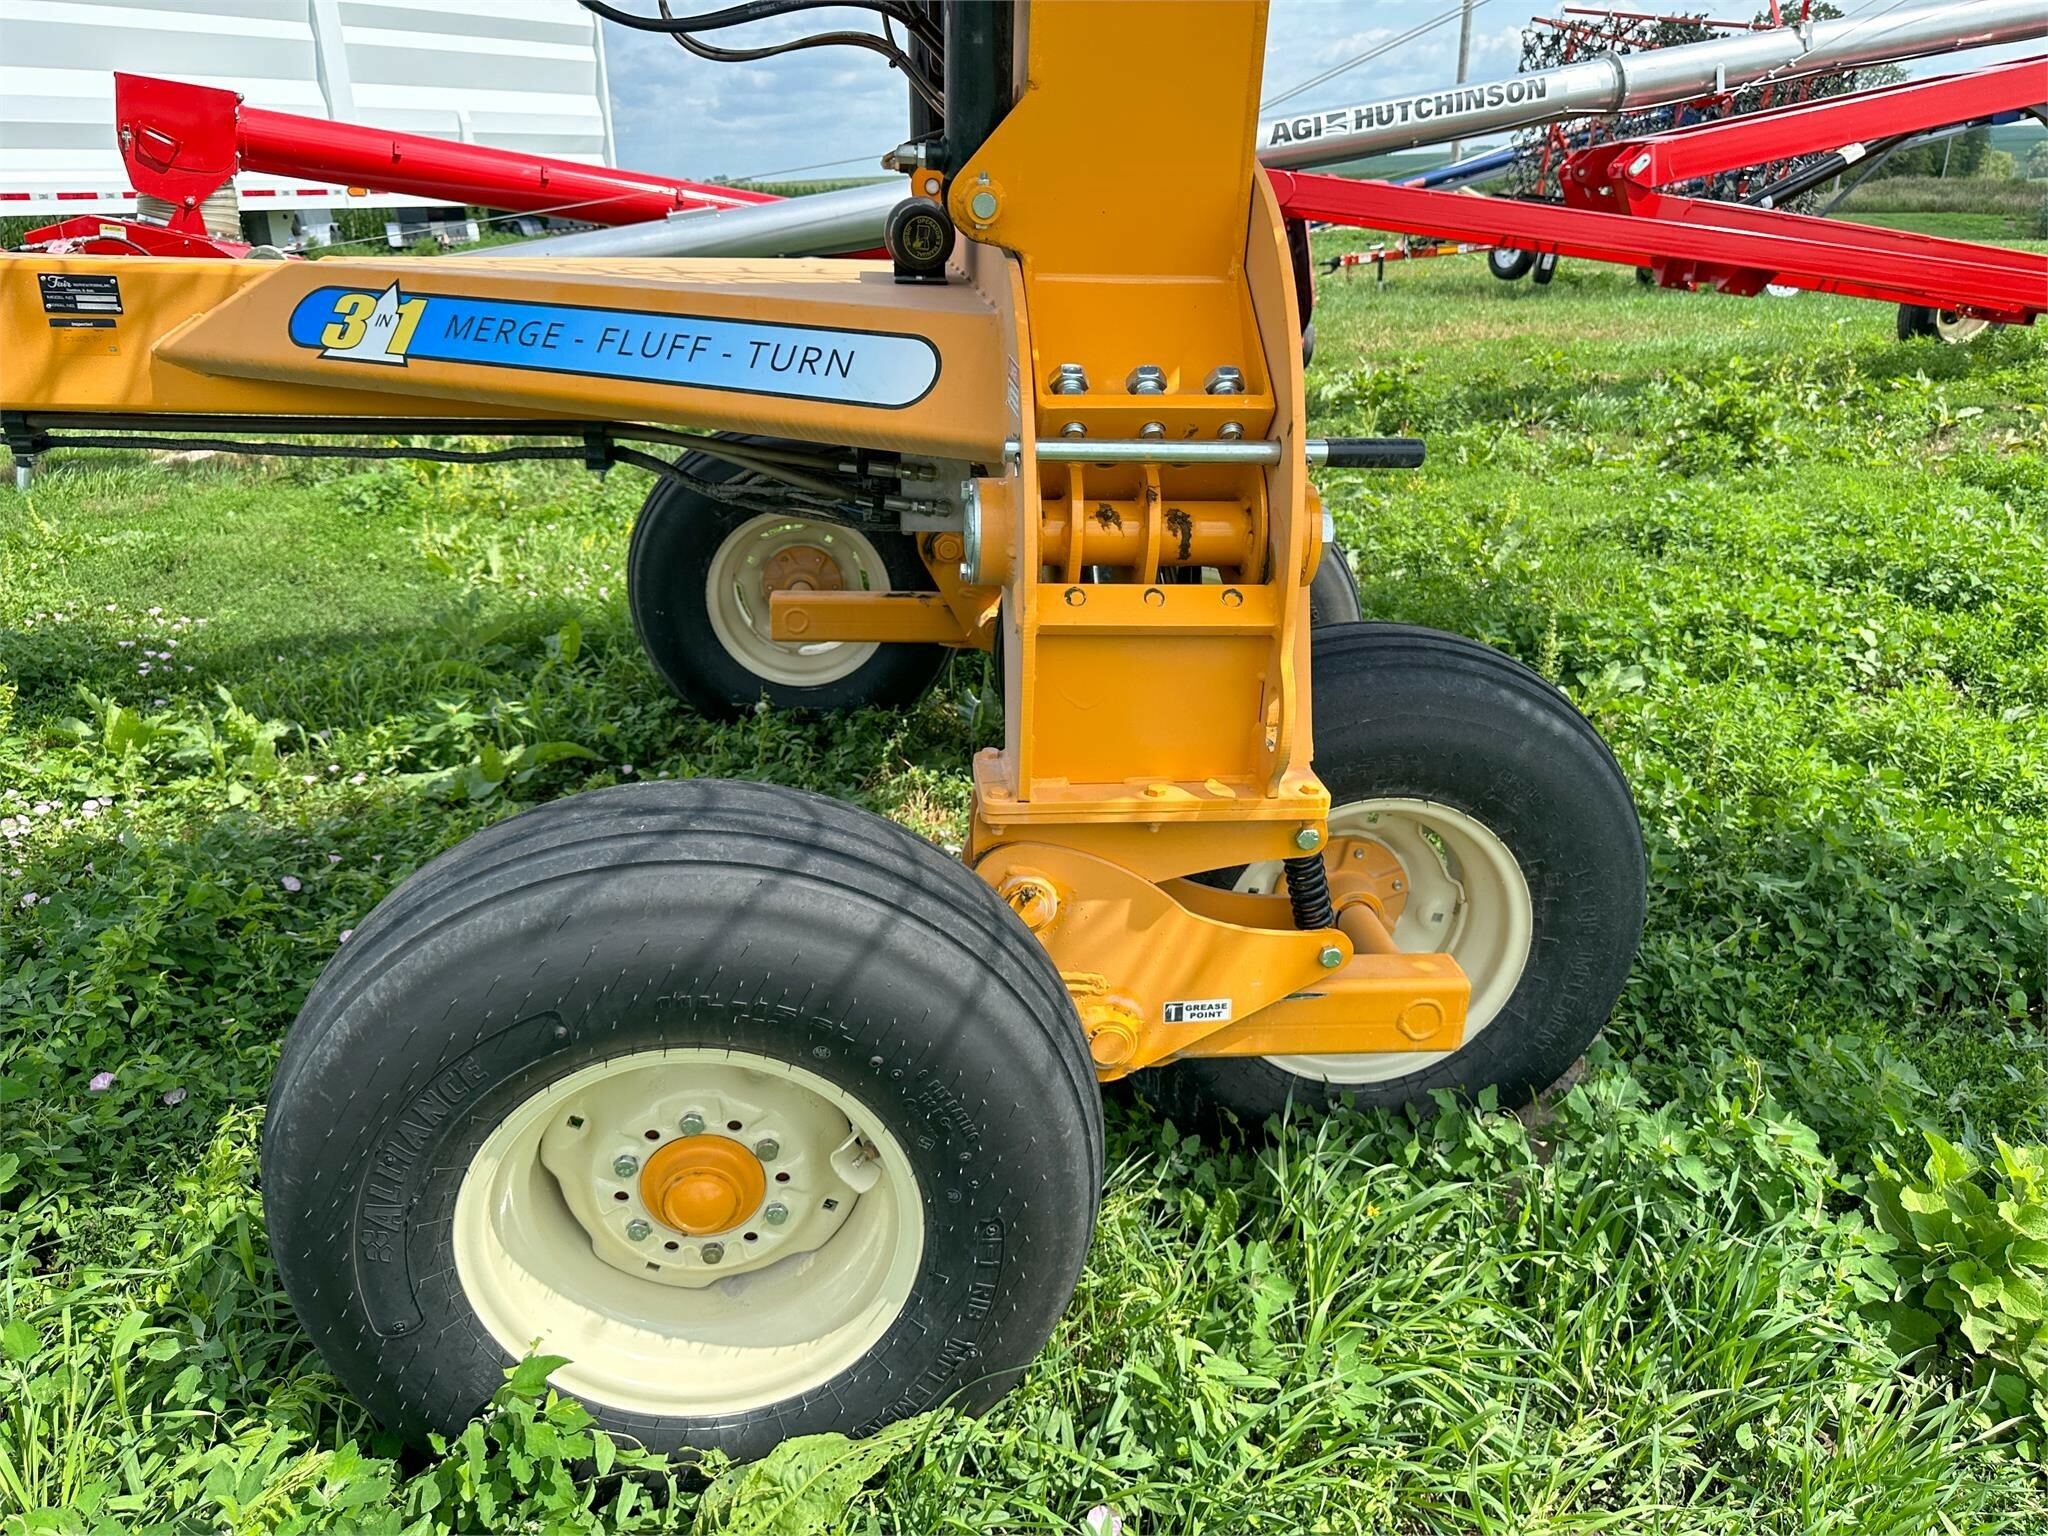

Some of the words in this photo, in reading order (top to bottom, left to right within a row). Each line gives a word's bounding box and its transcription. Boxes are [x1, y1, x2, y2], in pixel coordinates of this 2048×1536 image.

[1270, 116, 1322, 145] AGI
[1355, 77, 1547, 131] HUTCHINSON
[320, 293, 375, 349] 3
[375, 313, 393, 328] IN
[385, 298, 426, 355] 1
[445, 314, 565, 349] MERGE
[596, 327, 713, 364] FLUFF
[749, 340, 857, 379] TURN
[1185, 1002, 1228, 1012] GREASE
[1190, 1011, 1223, 1020] POINT
[362, 1056, 489, 1232] ALLIANCE
[967, 1281, 997, 1320] RIB
